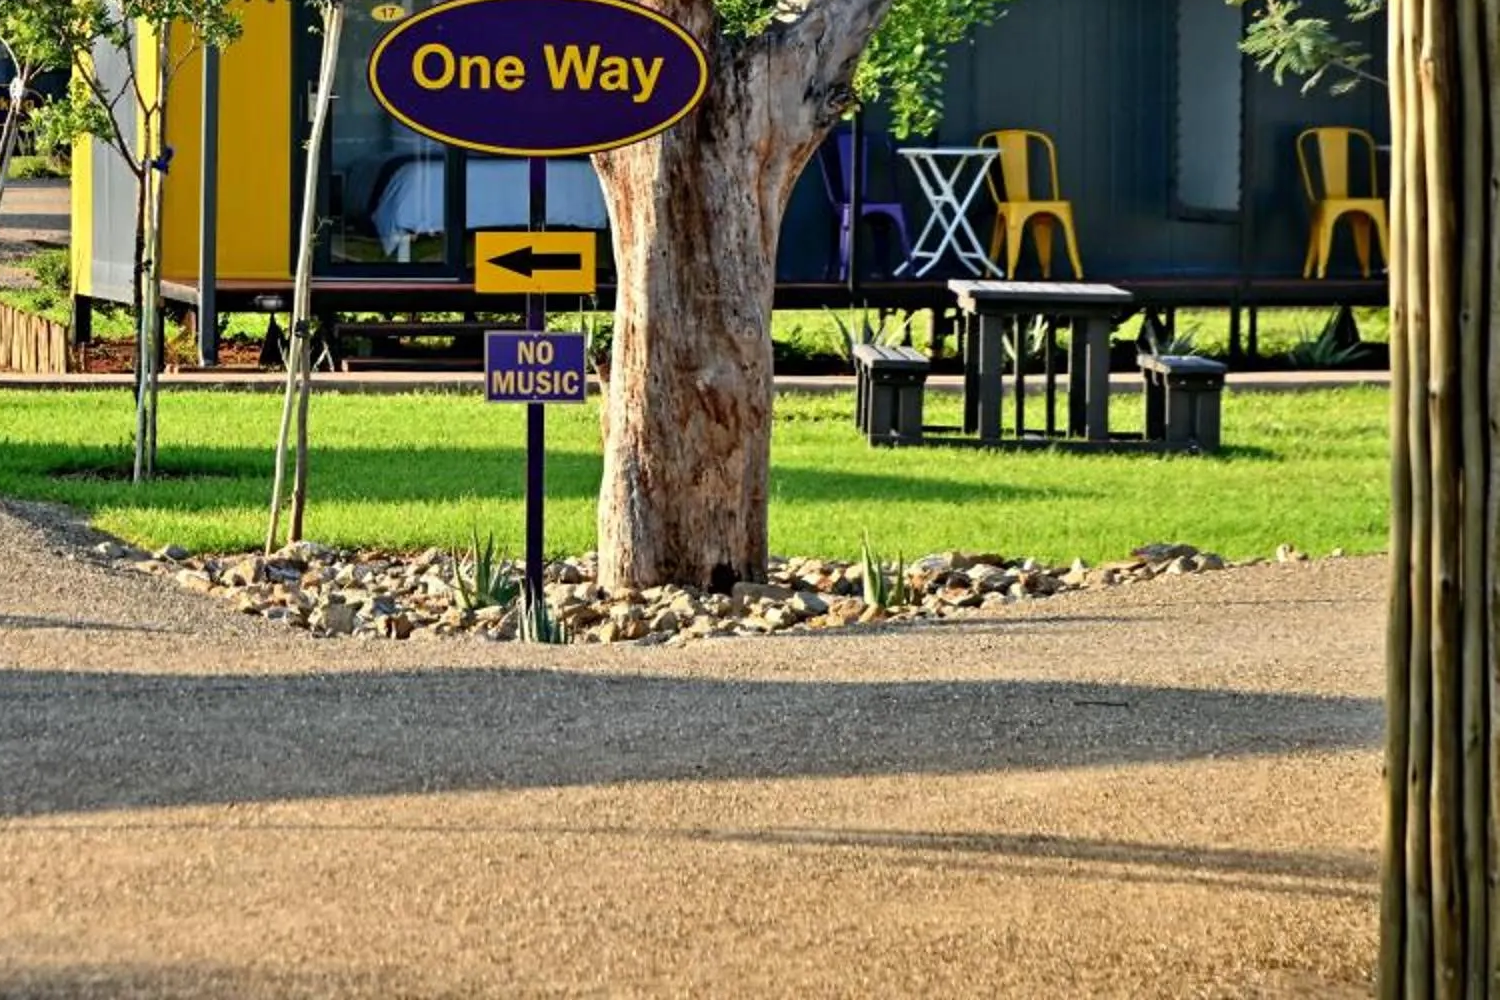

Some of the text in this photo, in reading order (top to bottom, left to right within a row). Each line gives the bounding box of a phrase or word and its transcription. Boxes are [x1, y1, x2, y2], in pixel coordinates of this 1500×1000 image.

[412, 43, 664, 103] One Way
[517, 340, 554, 366] NO
[491, 369, 580, 396] MUSIC
